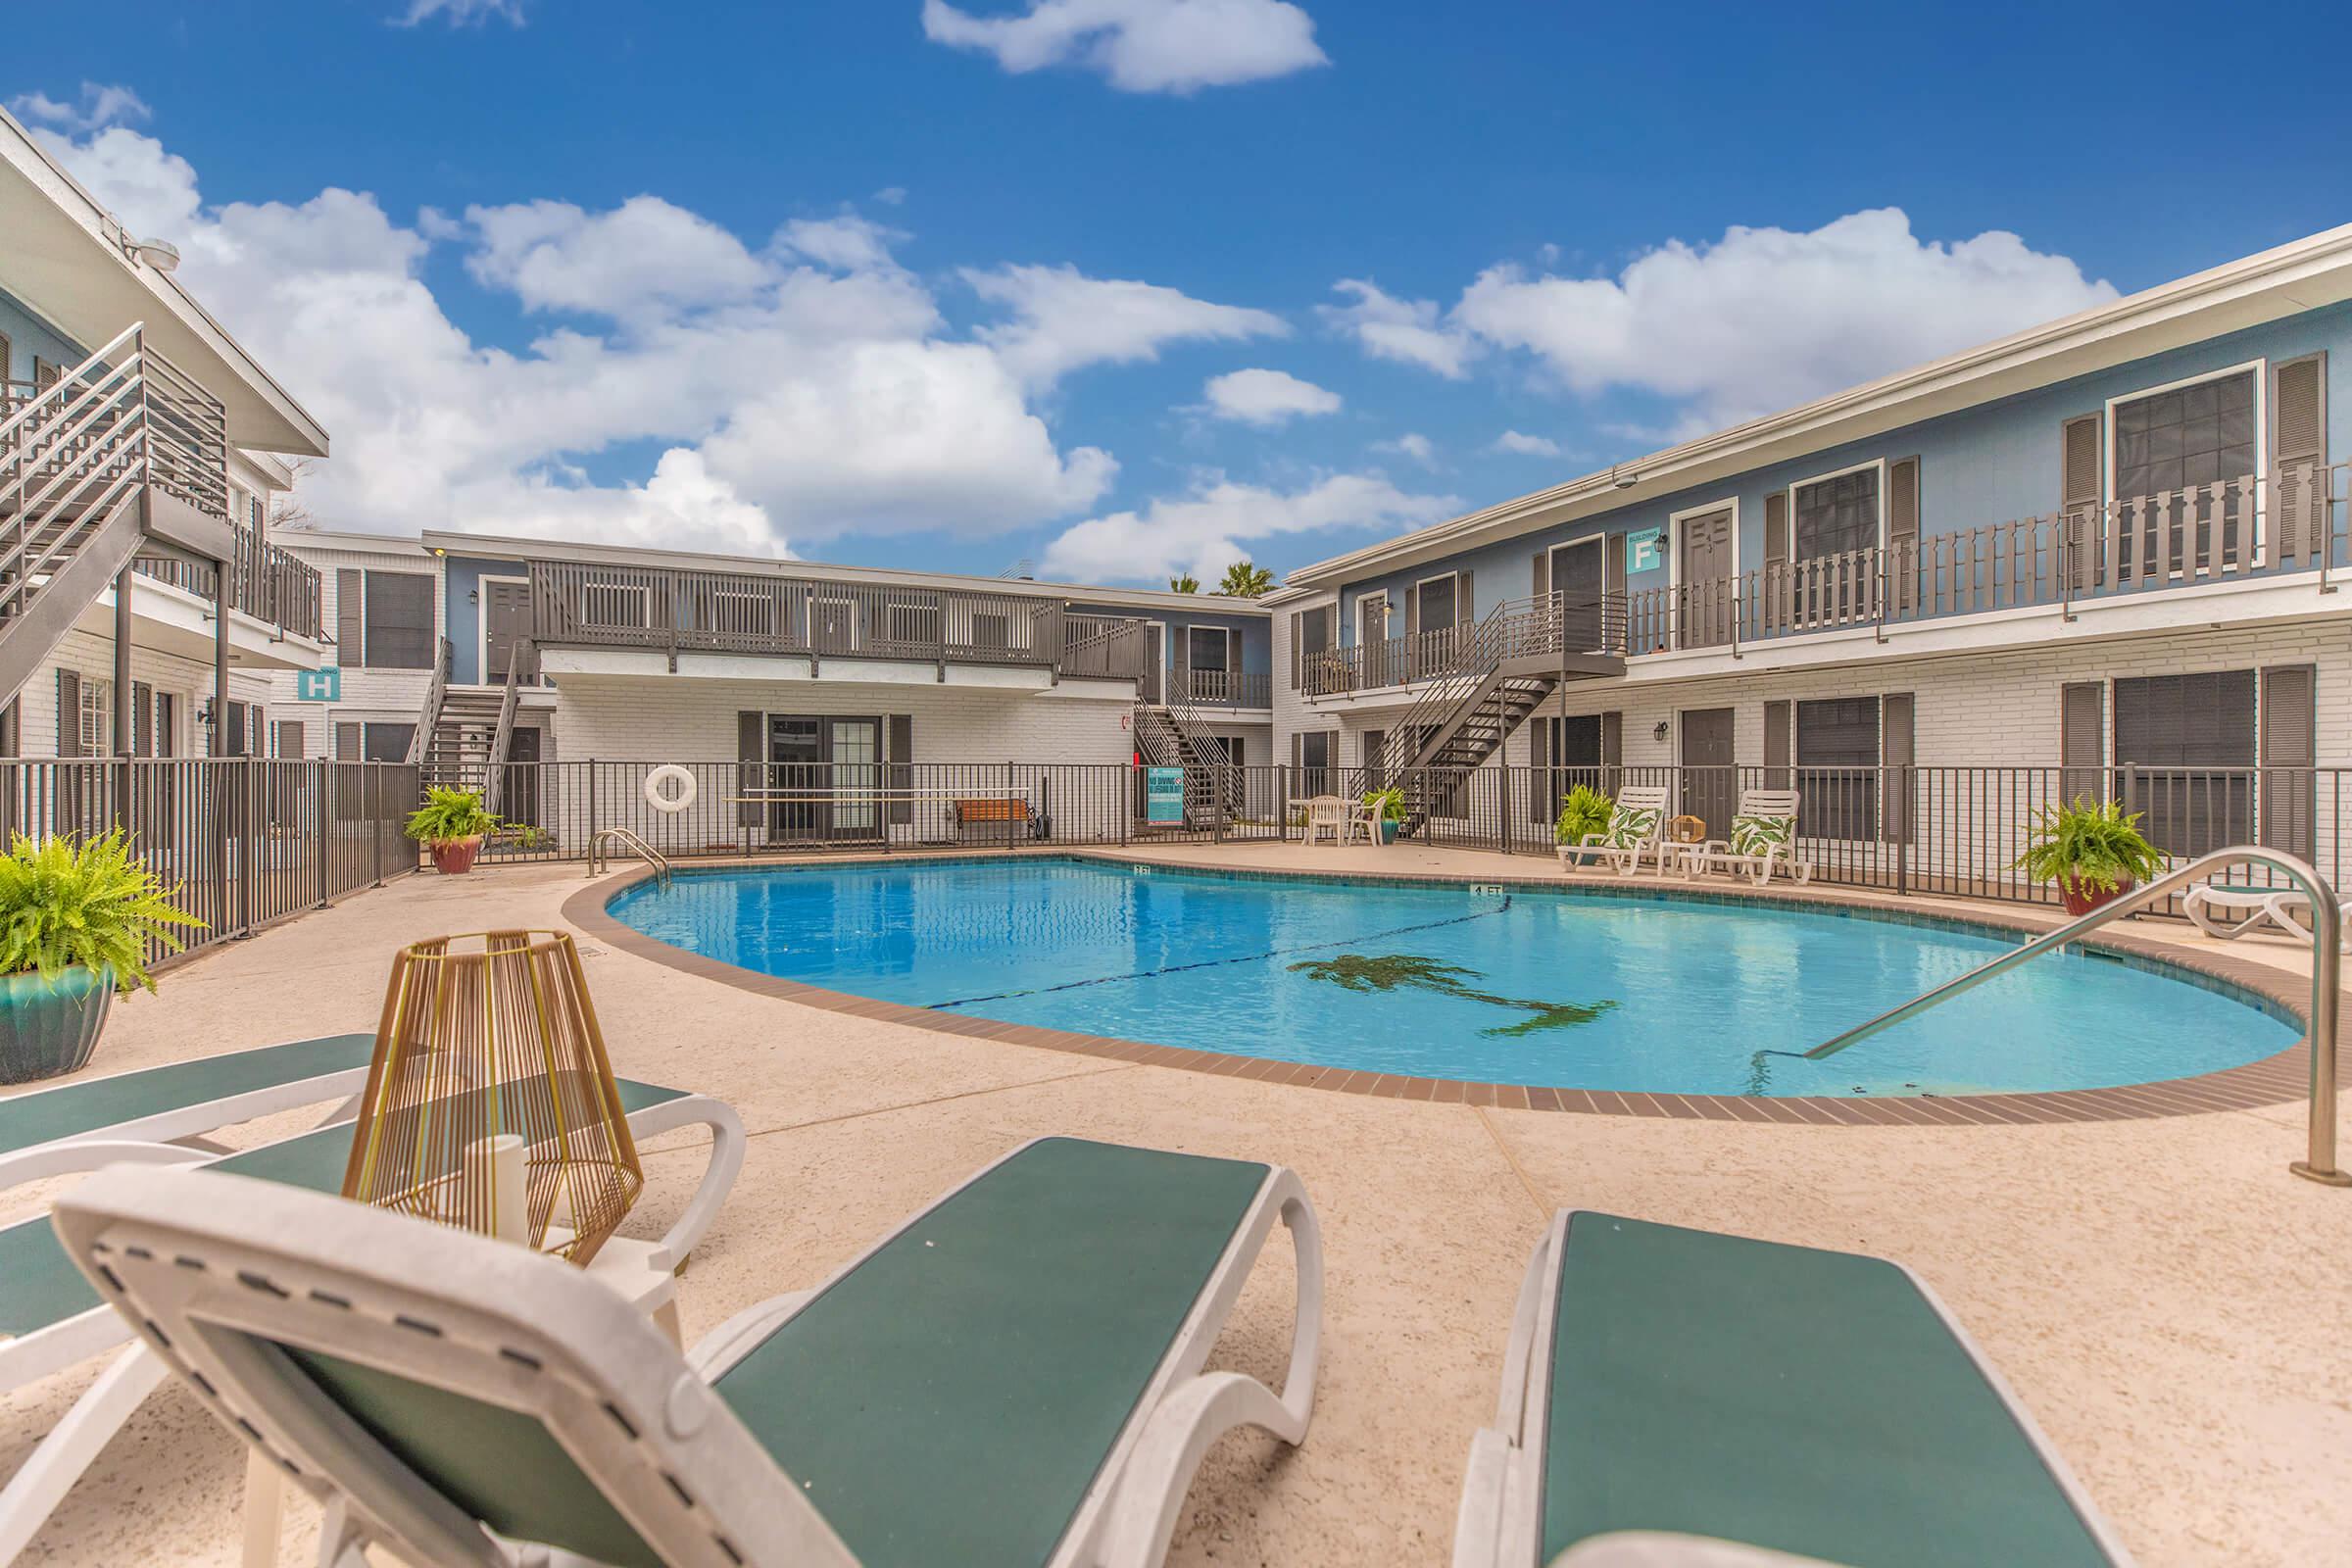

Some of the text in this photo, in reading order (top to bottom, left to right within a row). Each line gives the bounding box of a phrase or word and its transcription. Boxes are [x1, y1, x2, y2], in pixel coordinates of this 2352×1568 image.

[1629, 531, 1657, 542] BUILDING
[1635, 540, 1653, 568] F
[308, 675, 331, 697] H
